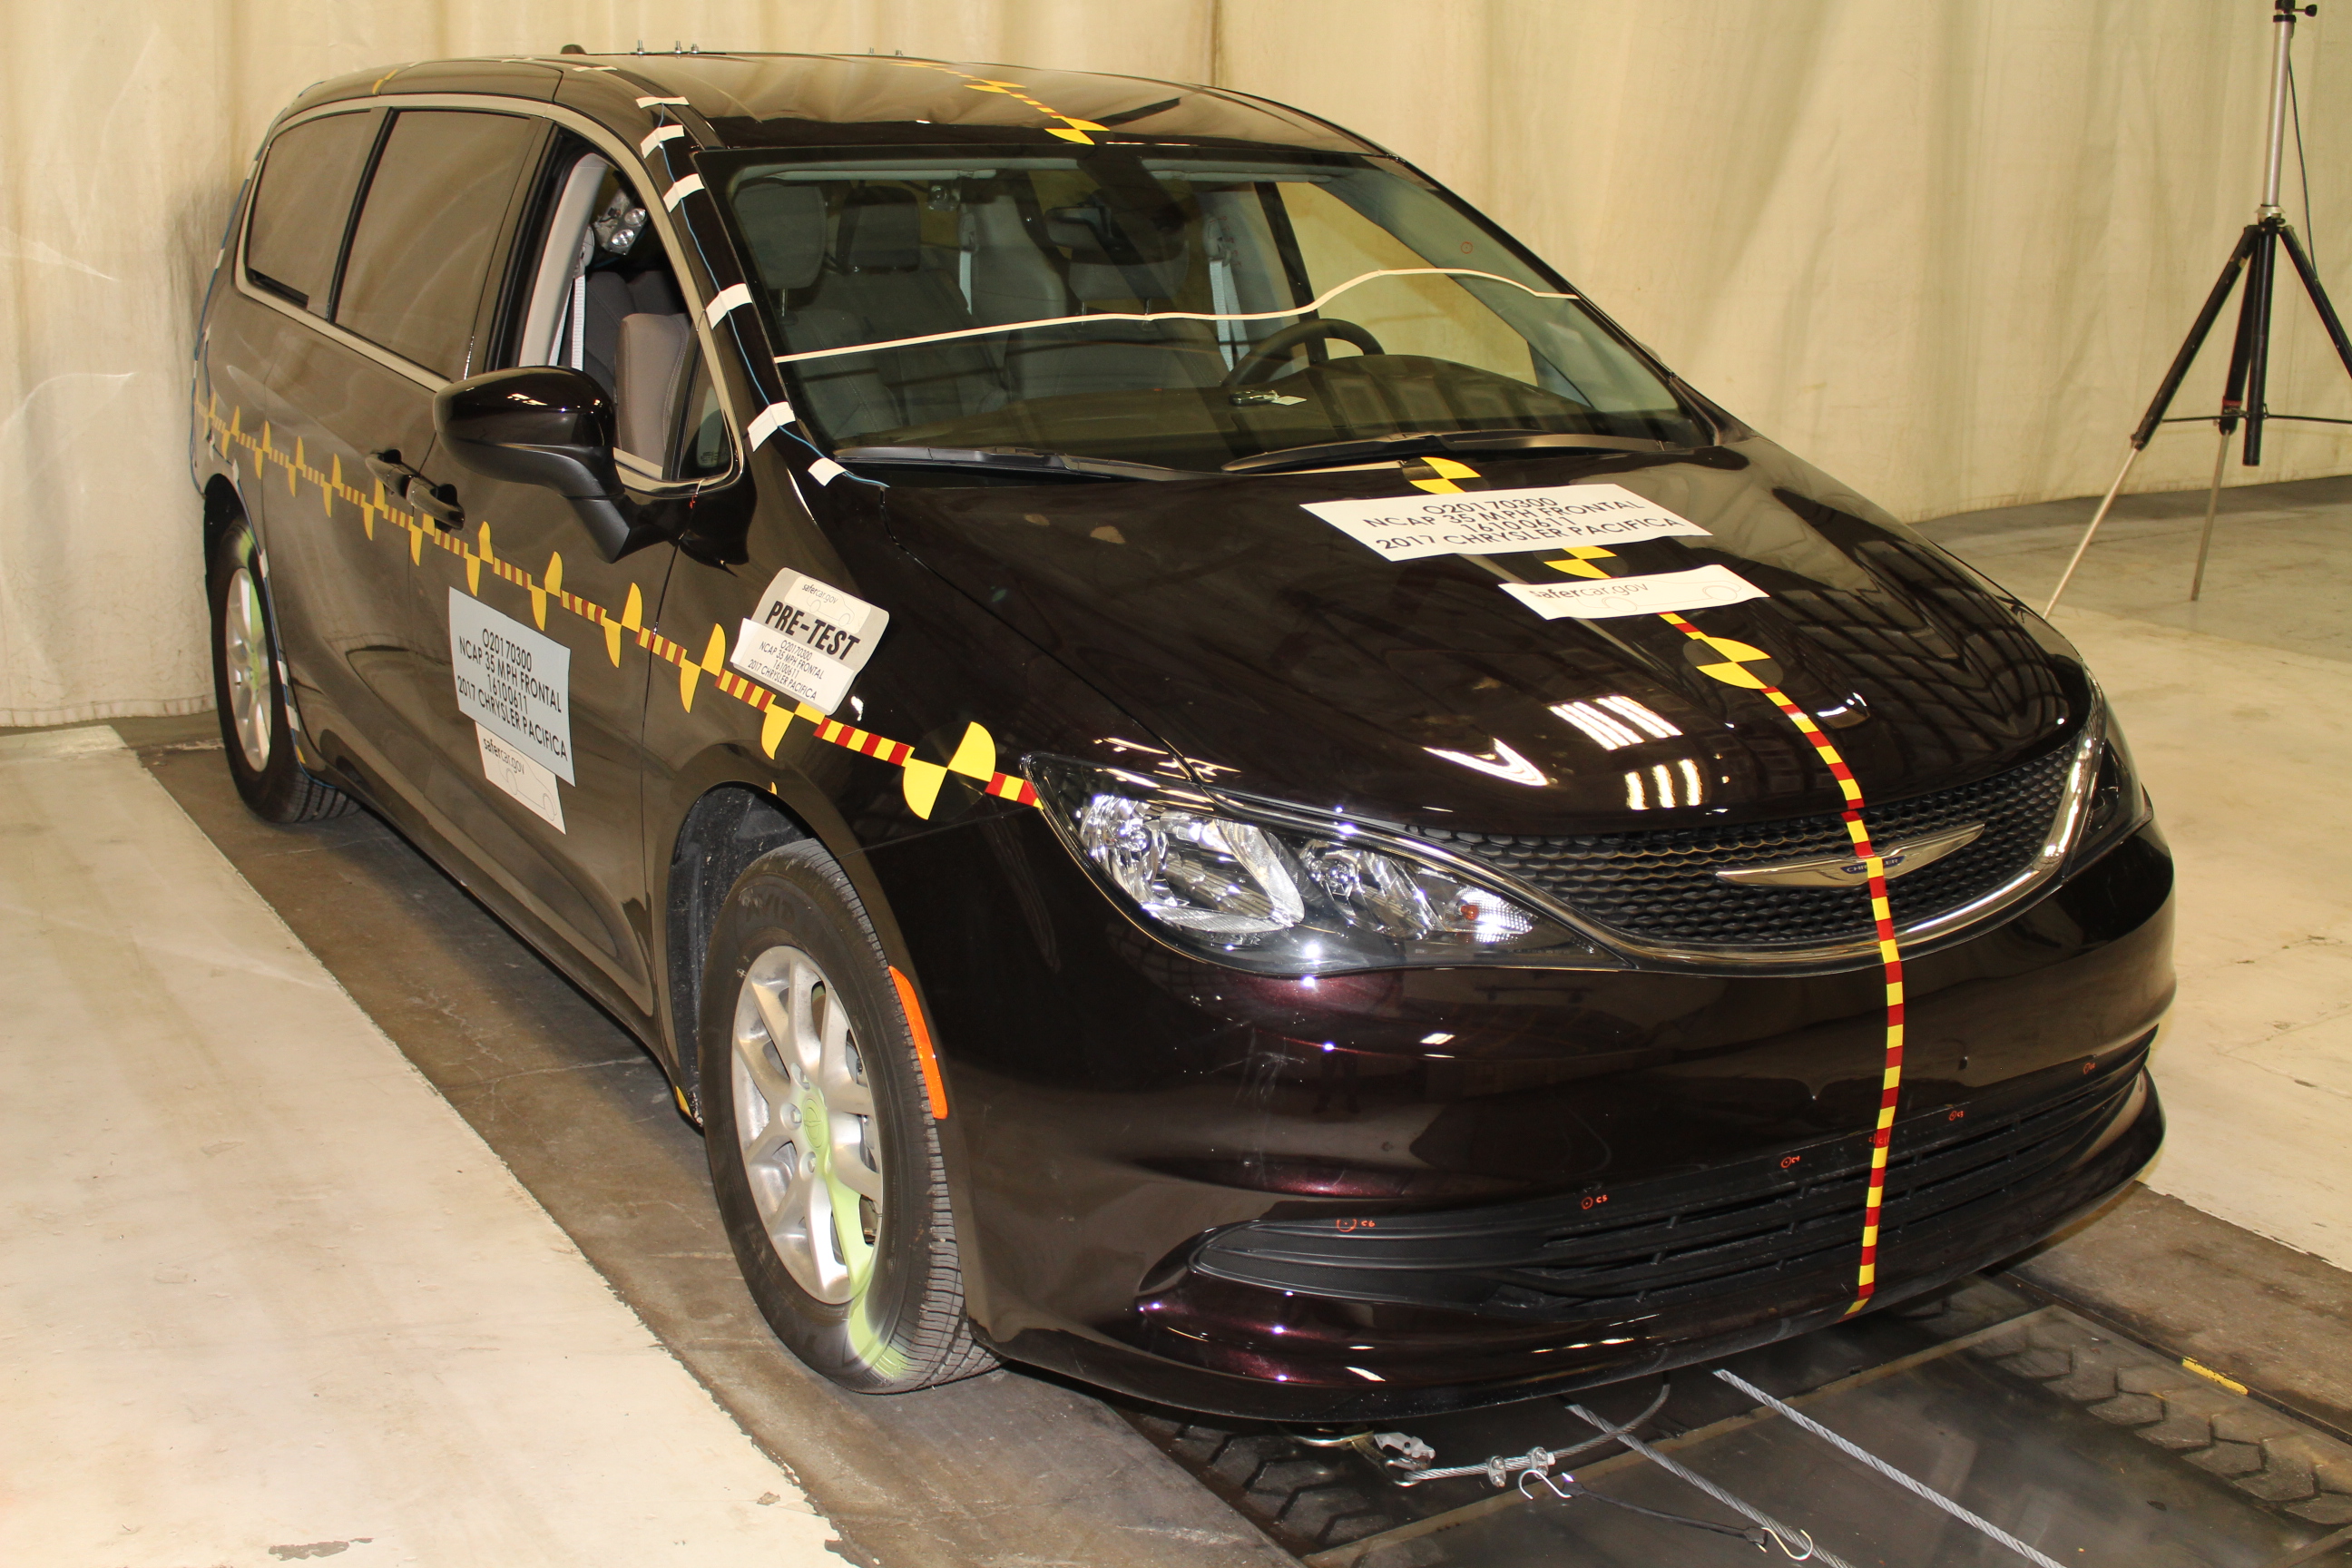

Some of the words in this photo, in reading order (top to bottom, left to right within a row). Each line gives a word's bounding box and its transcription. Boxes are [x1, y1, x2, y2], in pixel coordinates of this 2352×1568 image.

[1363, 515, 1436, 528] NCAP
[1443, 514, 1475, 524] 35
[1479, 508, 1539, 522] MPH
[1538, 500, 1645, 517] FRONTAL
[1461, 516, 1575, 533] 16100611
[1376, 534, 1436, 550] 2017
[1444, 525, 1570, 545] CHRYSLER
[1573, 517, 1685, 535] PACIFICA
[802, 583, 838, 603] safercar.gov
[1529, 582, 1649, 600] safercar.gov
[765, 600, 861, 661] PRE-TEST
[459, 635, 483, 664] NCAP
[485, 651, 495, 673] 35
[497, 658, 518, 688] MPH
[520, 671, 562, 713] FRONTAL
[759, 641, 778, 655] NCAP
[776, 649, 784, 660] 35
[785, 654, 798, 665] MPH
[798, 661, 824, 680] FRONTAL
[772, 660, 799, 678] 16100611
[487, 673, 528, 715] 16100611
[747, 659, 761, 671] 2017
[760, 665, 789, 685] CHRYSLER
[788, 681, 817, 701] PACIFICA
[457, 675, 476, 701] 2017
[478, 688, 522, 731] CHRYSLER
[522, 715, 568, 761] PACIFICA
[483, 737, 525, 775] safercar.gov
